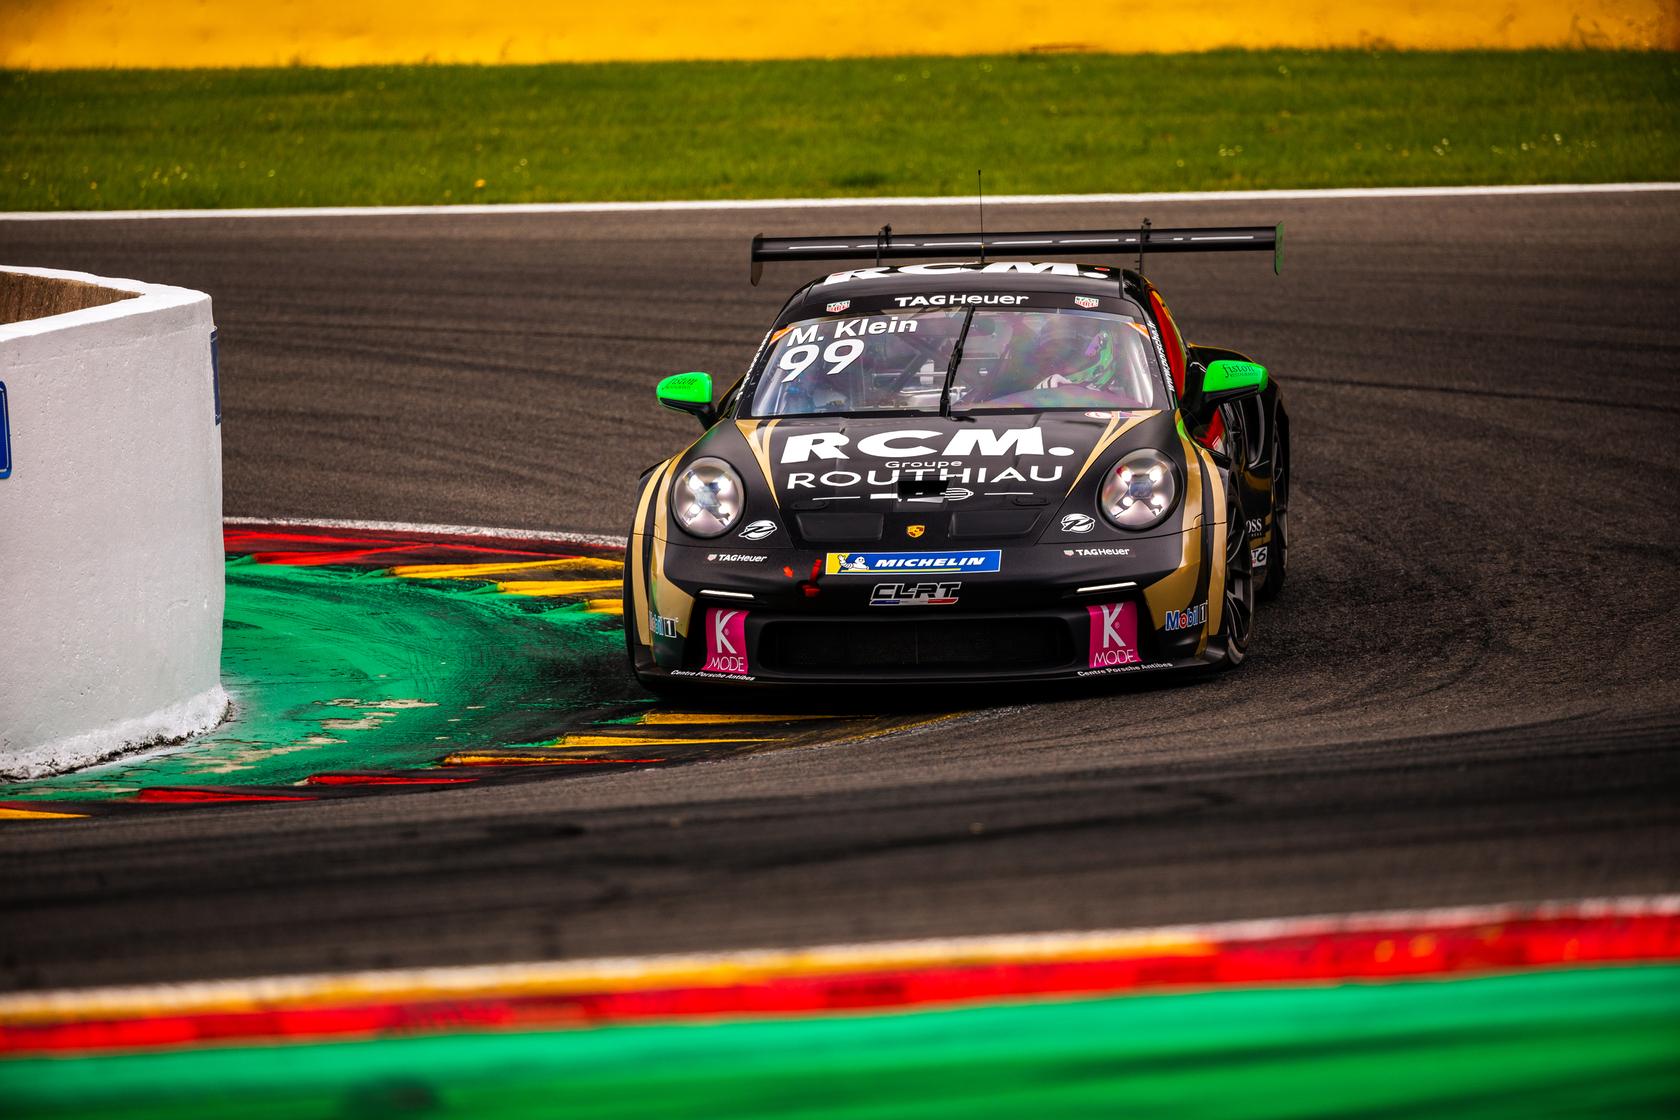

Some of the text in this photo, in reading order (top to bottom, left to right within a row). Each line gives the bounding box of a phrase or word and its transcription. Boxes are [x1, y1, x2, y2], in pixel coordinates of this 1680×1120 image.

[787, 318, 918, 347] M. Klein
[779, 339, 865, 383] 99
[780, 427, 1075, 464] RCM.
[885, 461, 962, 469] Groupe
[787, 465, 1063, 490] ROUTHIAU
[875, 557, 986, 568] MICHELIN
[871, 582, 962, 600] CLRT
[1100, 602, 1126, 648] K
[1165, 604, 1200, 631] Mobil
[715, 610, 739, 654] K
[707, 656, 745, 672] MODE
[1094, 649, 1137, 667] MODE
[670, 669, 697, 677] Centre
[696, 671, 725, 679] Porsche
[1077, 661, 1174, 677] Centre Porsche Antibes
